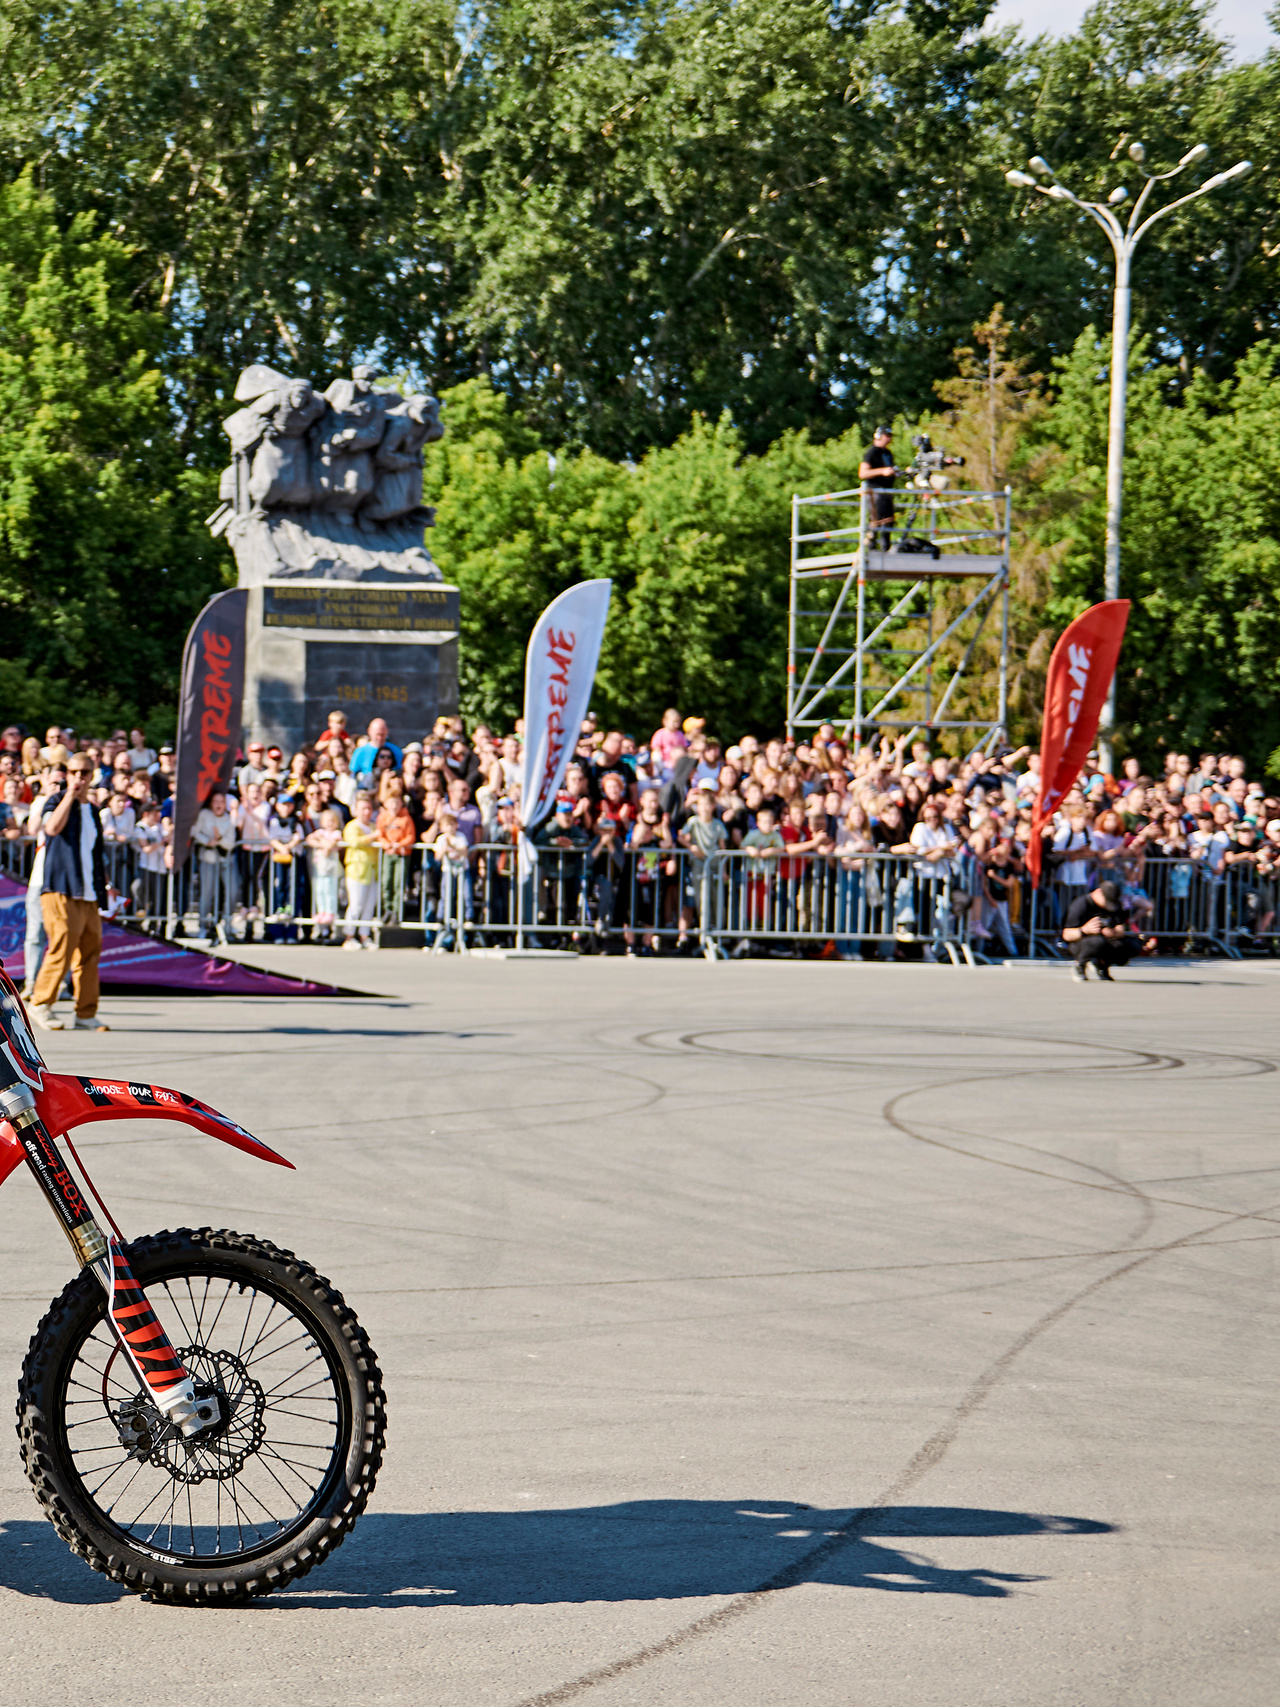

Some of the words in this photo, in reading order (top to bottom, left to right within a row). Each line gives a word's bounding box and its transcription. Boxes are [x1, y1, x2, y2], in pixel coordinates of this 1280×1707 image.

[84, 1085, 124, 1095] CHOOSE
[127, 1085, 152, 1097] YOUR
[154, 1090, 179, 1103] FATE
[25, 1140, 47, 1170] off-road
[42, 1170, 53, 1190] racing
[52, 1188, 74, 1225] suspensions
[54, 1168, 88, 1218] BOX
